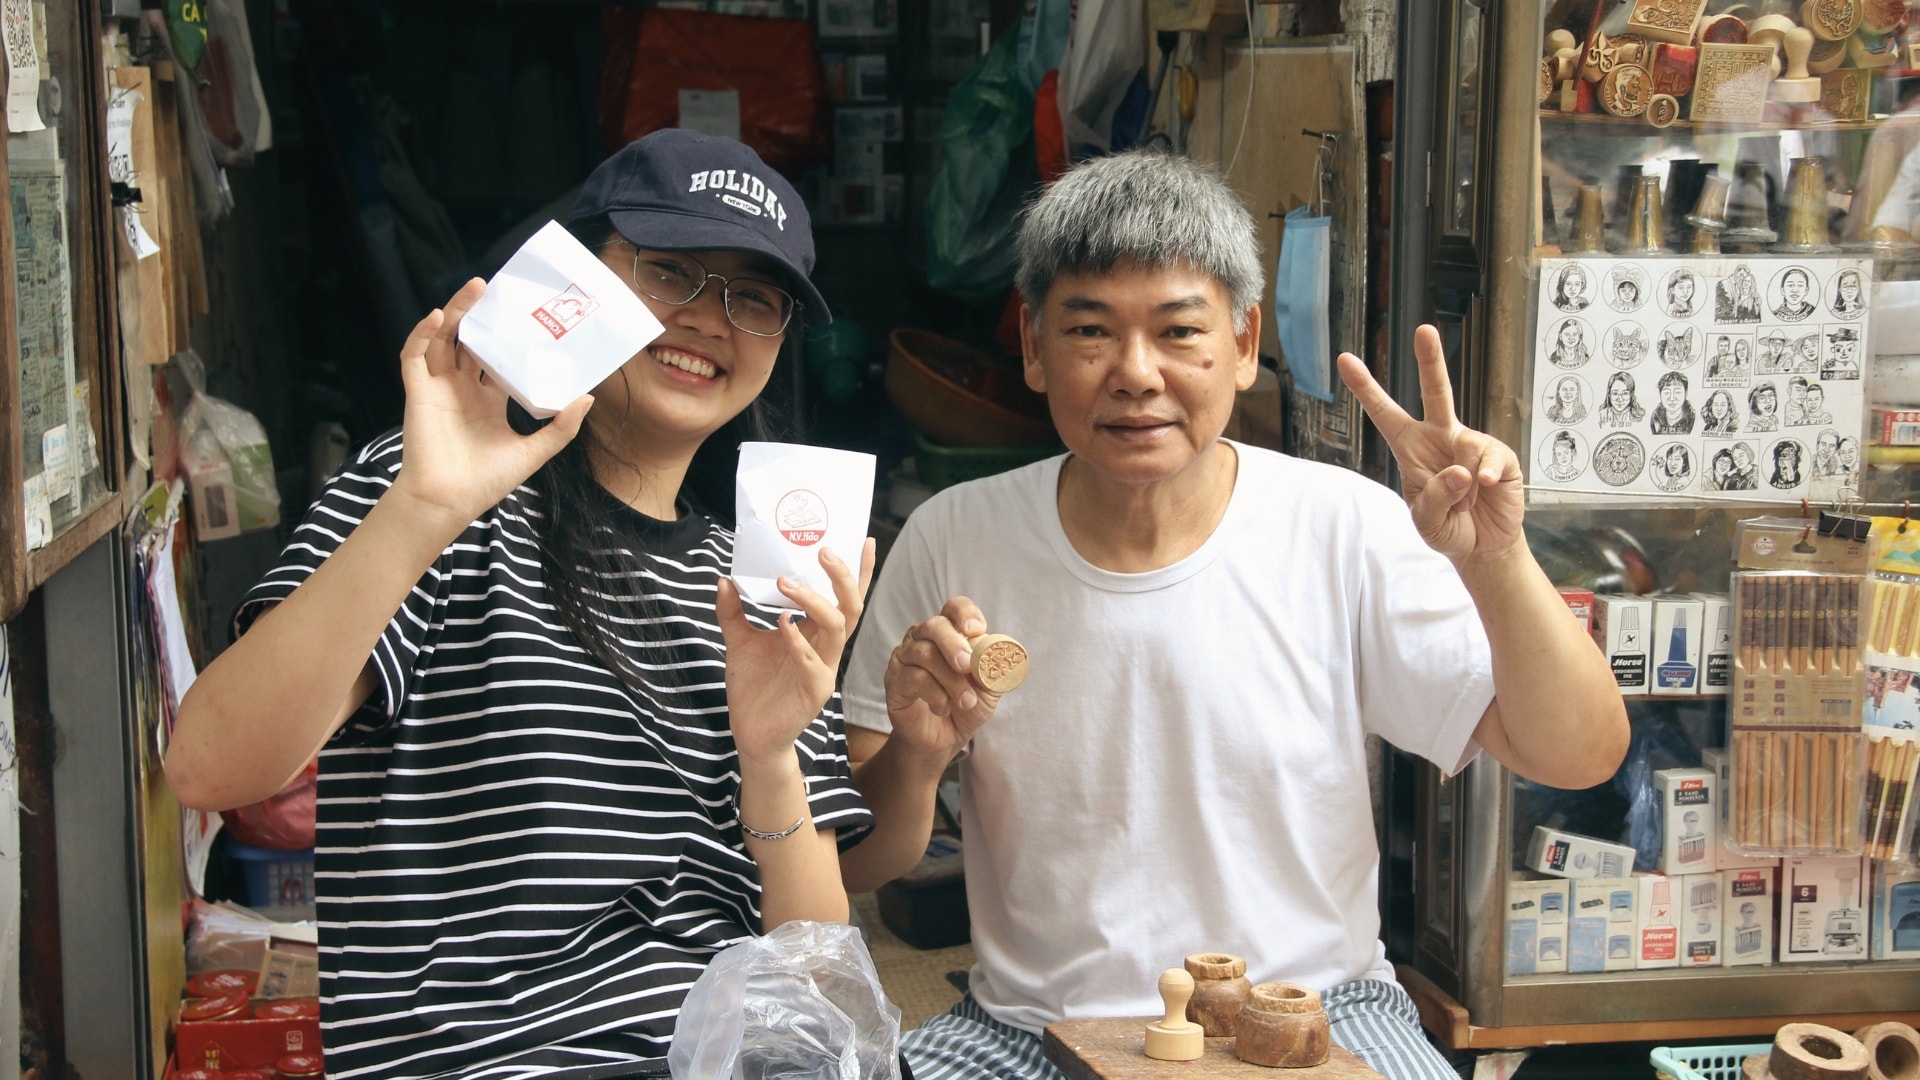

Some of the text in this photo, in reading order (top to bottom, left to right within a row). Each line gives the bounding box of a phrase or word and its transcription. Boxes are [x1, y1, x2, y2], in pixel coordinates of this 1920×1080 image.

[689, 169, 787, 231] HOLIDAY
[727, 197, 758, 213] NEW YORK
[536, 311, 562, 336] HANOI
[1772, 481, 1796, 489] ANGUS
[1612, 658, 1642, 666] Horse
[1801, 887, 1809, 897] 6
[1644, 932, 1673, 940] Horse
